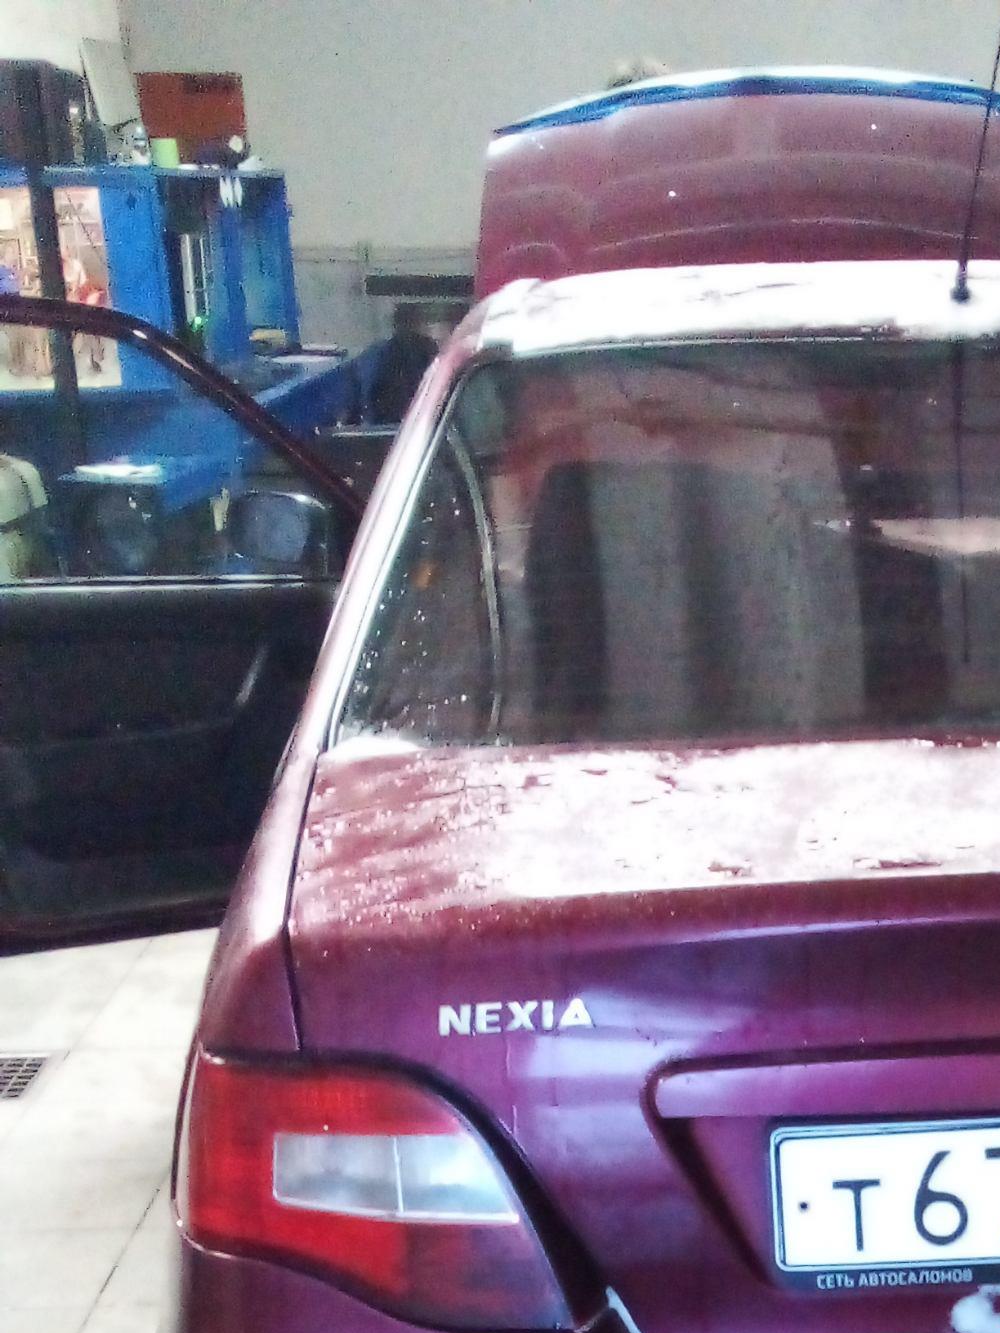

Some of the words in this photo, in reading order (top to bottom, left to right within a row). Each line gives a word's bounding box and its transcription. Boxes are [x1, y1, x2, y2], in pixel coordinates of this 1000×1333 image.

[438, 998, 593, 1036] NEXIA
[817, 1273, 854, 1290] СЕТЬ
[858, 1268, 973, 1288] АВТОСАЛОНОВ
